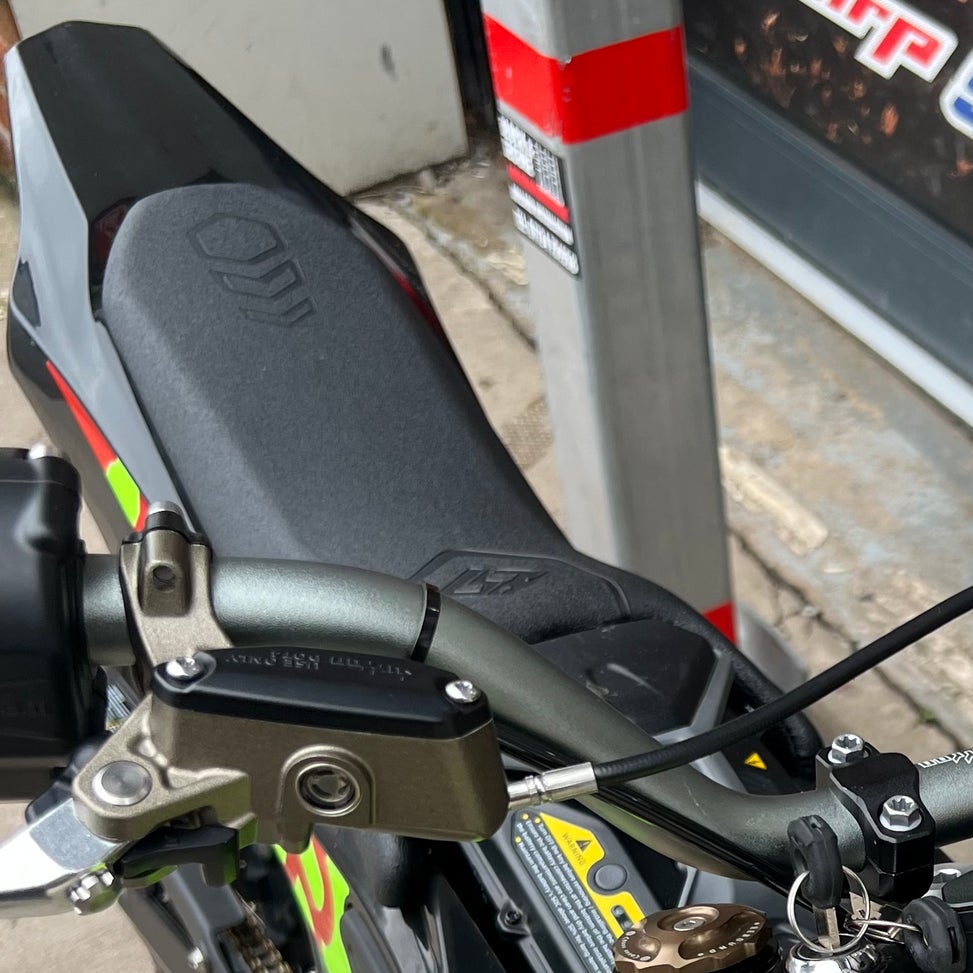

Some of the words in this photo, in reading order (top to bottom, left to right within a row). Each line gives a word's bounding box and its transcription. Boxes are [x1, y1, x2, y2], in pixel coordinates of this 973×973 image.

[818, 0, 947, 74] rp
[515, 821, 526, 833] the
[525, 819, 540, 839] Ensure
[520, 830, 537, 852] battery
[535, 836, 546, 847] the
[562, 833, 585, 866] WARNING
[539, 844, 557, 866] battery
[532, 849, 557, 886] compartment
[550, 843, 560, 855] the
[561, 862, 577, 881] before
[571, 880, 591, 907] removing
[589, 908, 609, 935] installing
[552, 864, 574, 894] connectors
[517, 841, 535, 866] Maintain
[531, 863, 540, 874] the
[556, 906, 571, 924] above
[573, 933, 583, 944] for
[553, 884, 563, 895] are
[559, 892, 573, 910] clean
[573, 898, 583, 910] the
[568, 907, 580, 920] and
[579, 907, 596, 929] bottom
[574, 918, 586, 931] dry
[580, 928, 596, 948] before
[595, 933, 606, 945] the
